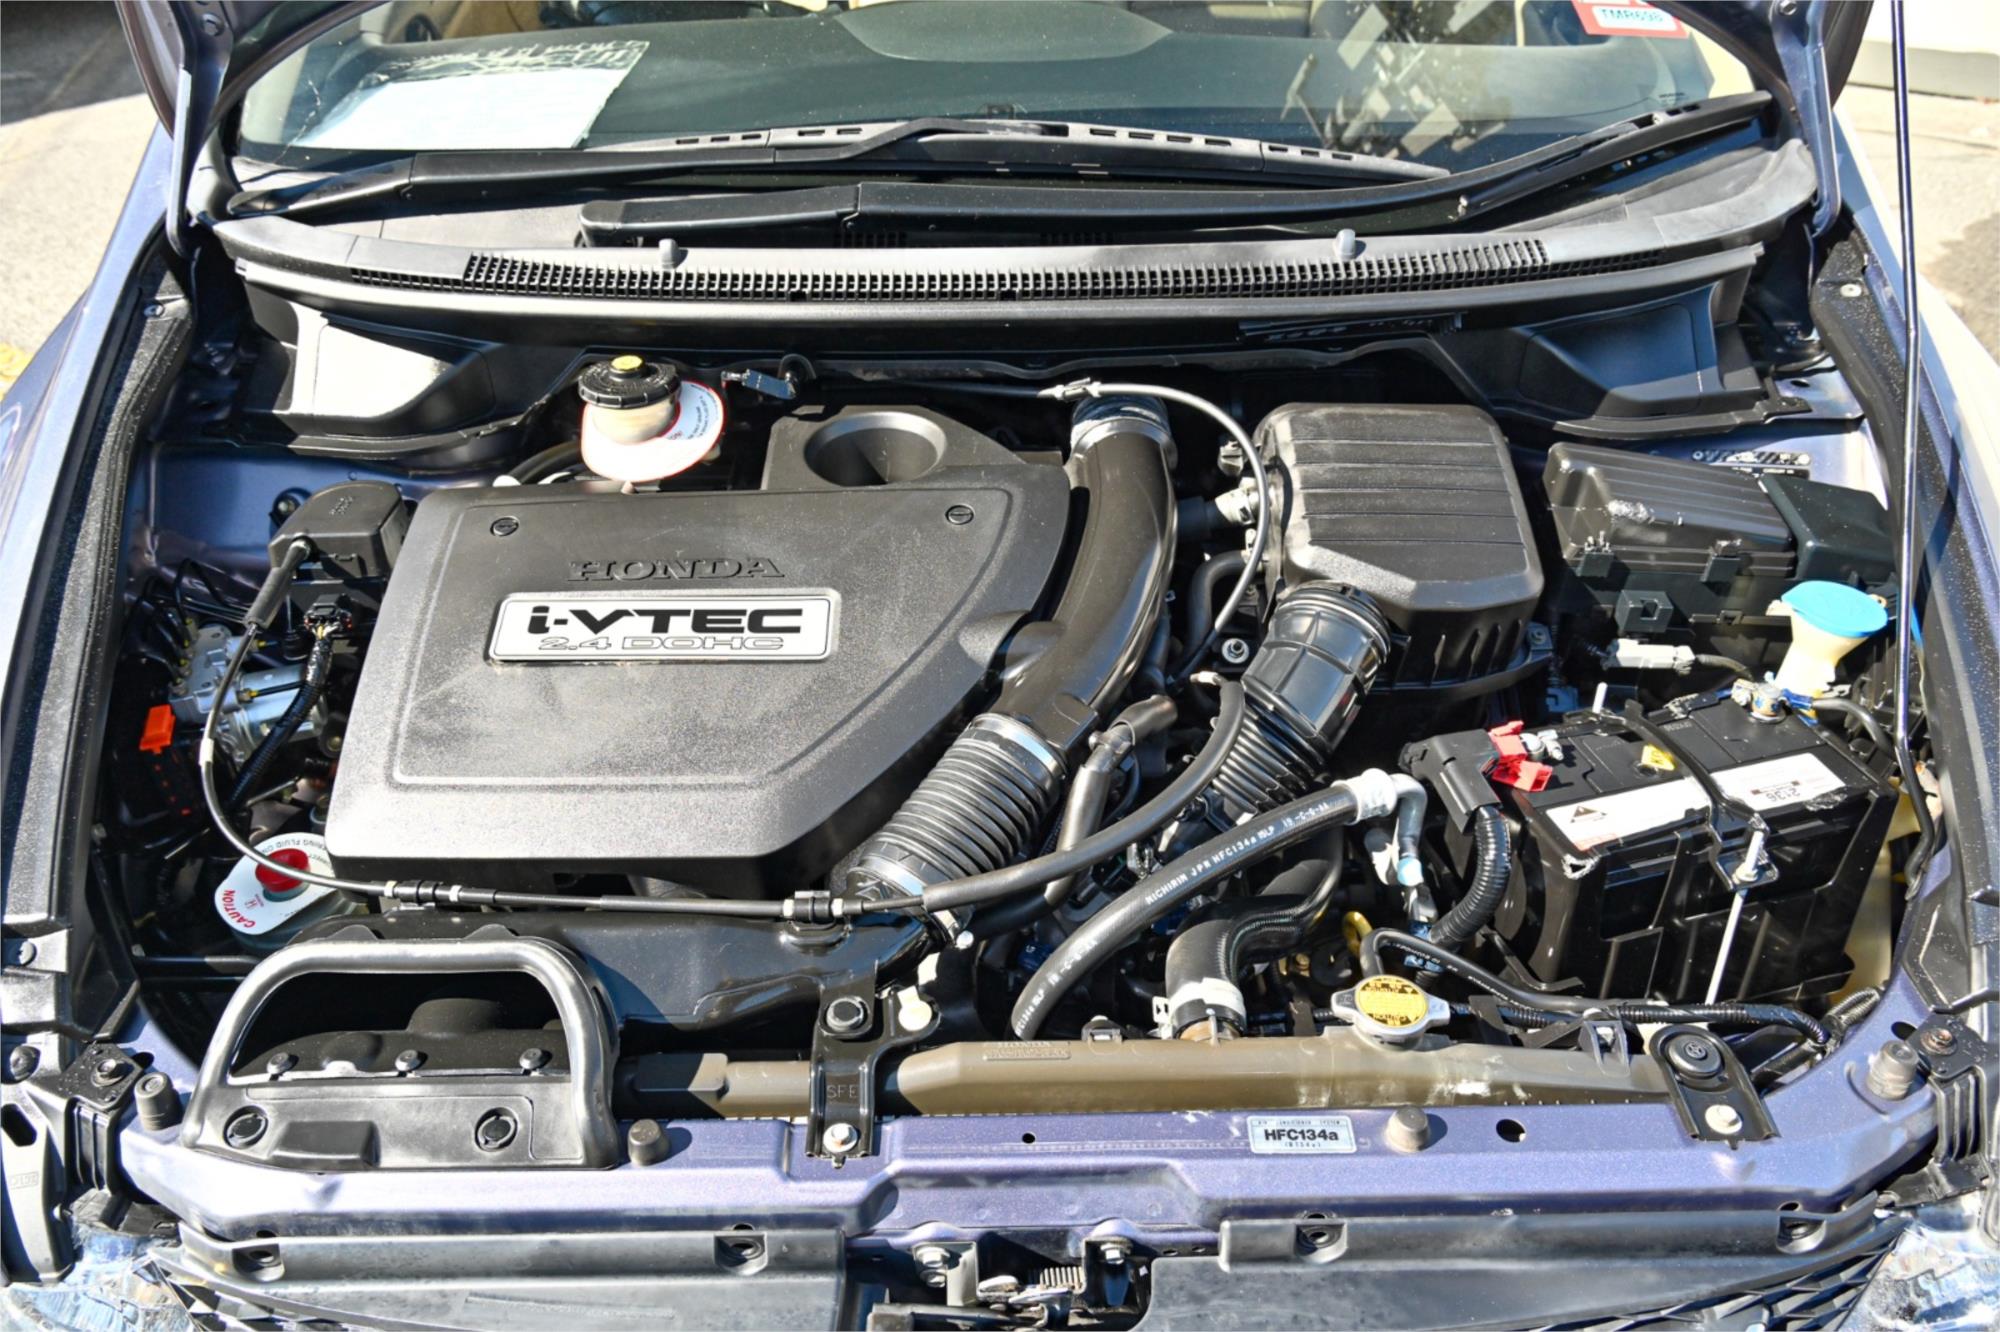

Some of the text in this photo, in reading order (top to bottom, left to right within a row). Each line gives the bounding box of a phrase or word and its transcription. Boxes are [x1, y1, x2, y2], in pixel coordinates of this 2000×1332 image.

[568, 558, 785, 581] HONDA
[527, 605, 804, 635] i-VTEC
[538, 636, 784, 651] 2.4 DOHC
[222, 888, 256, 929] CAUTION
[1264, 1128, 1340, 1142] HFC134a
